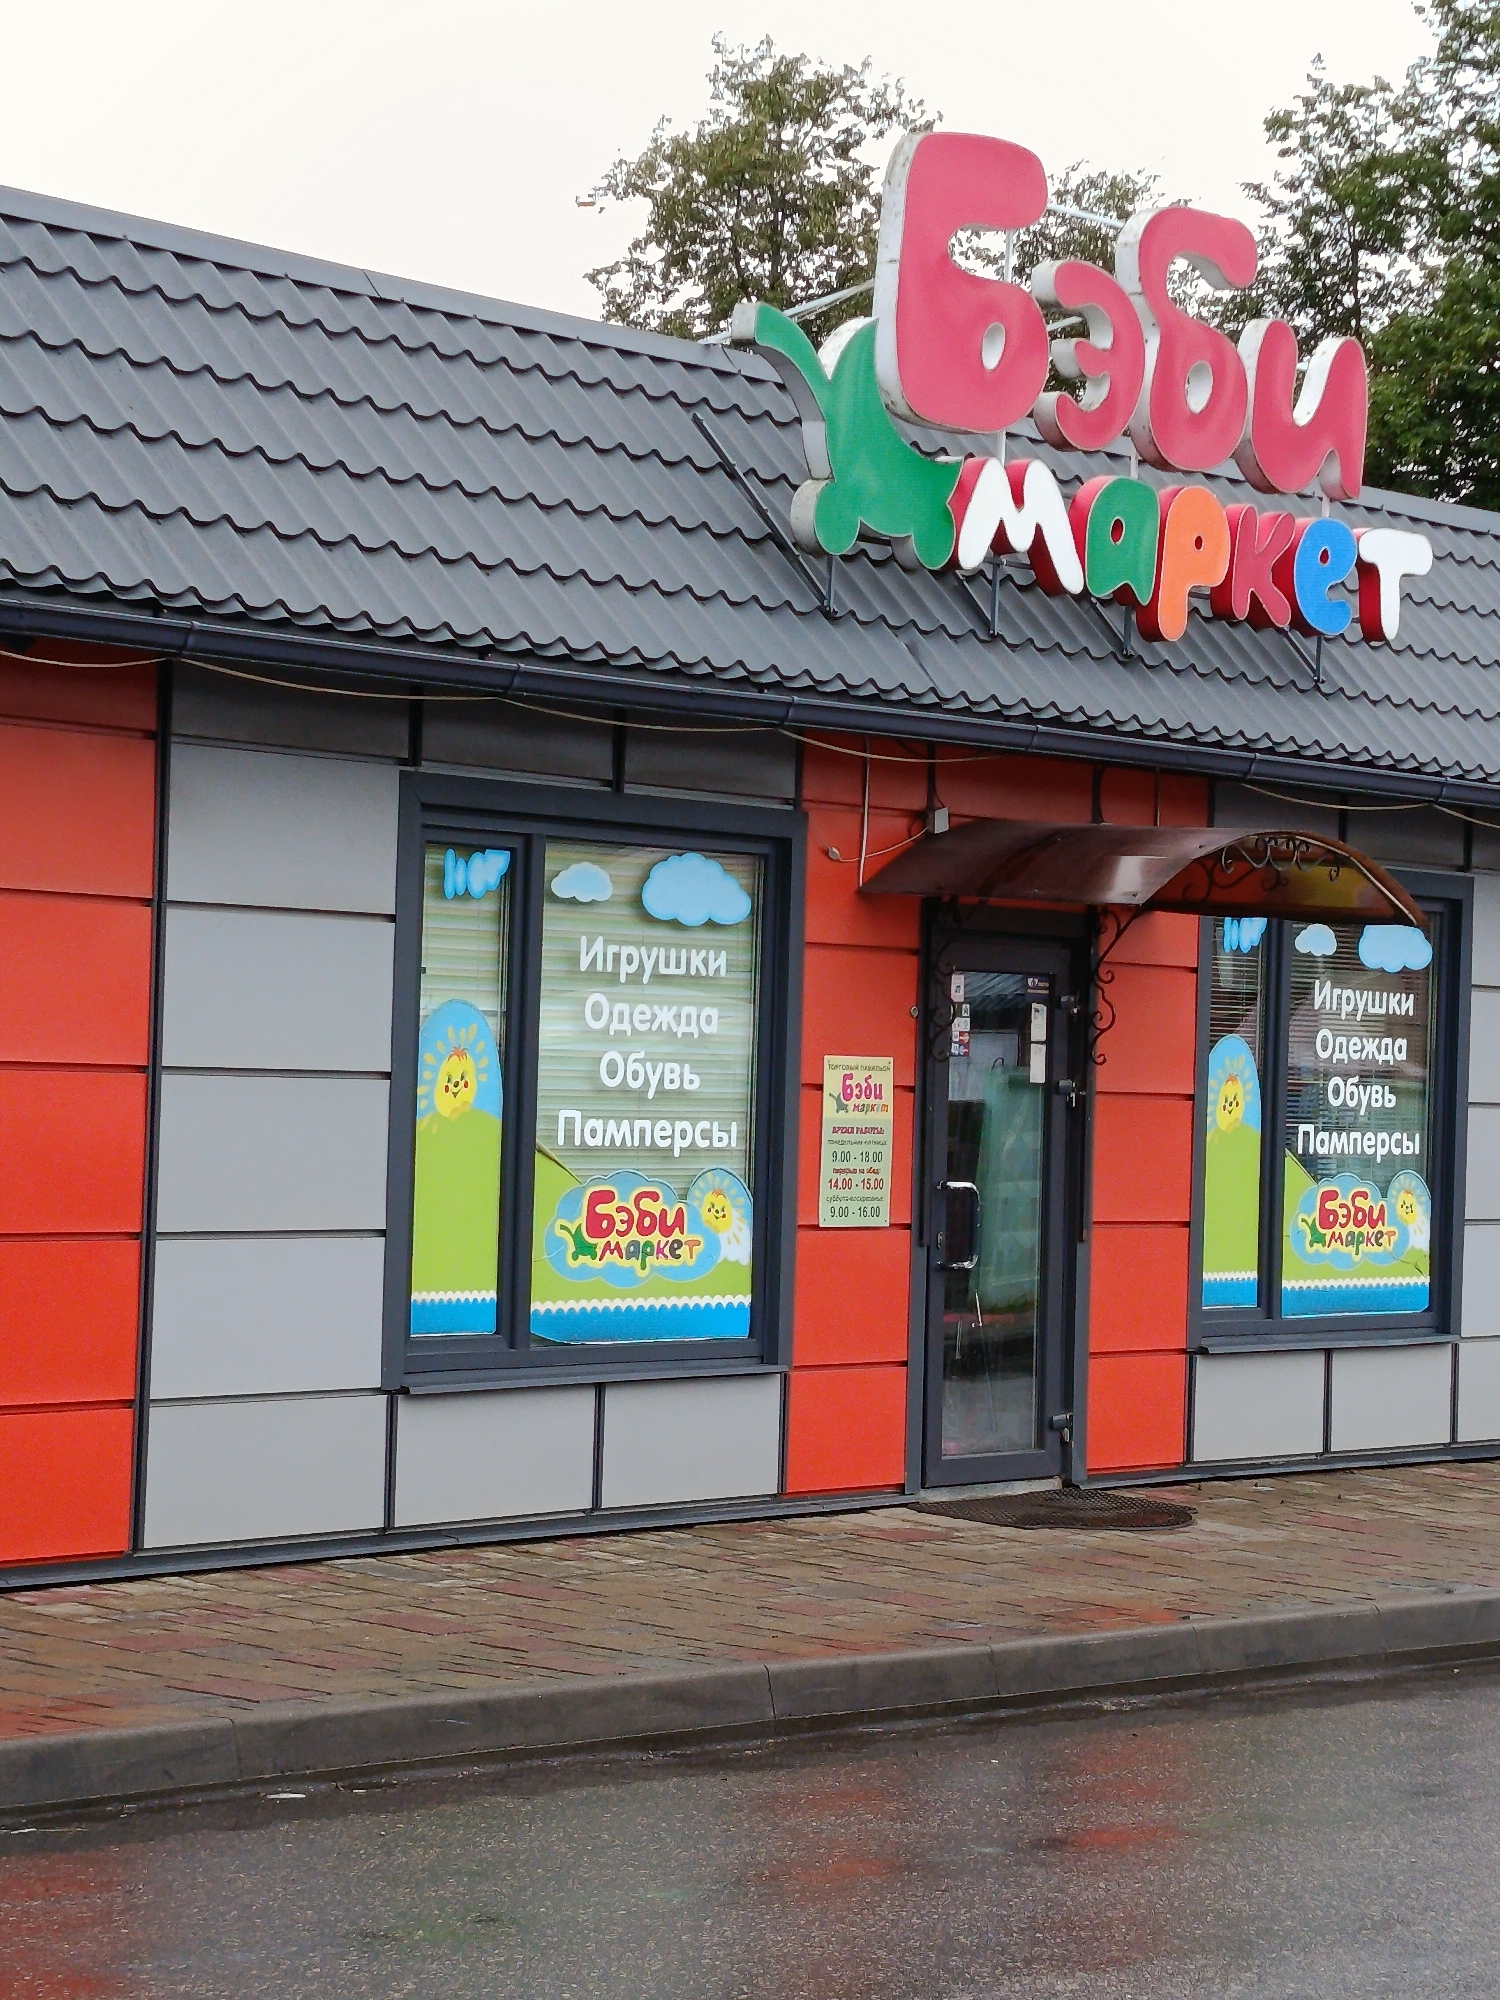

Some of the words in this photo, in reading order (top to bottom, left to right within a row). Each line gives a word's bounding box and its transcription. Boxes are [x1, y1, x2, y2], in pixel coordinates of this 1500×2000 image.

[873, 131, 1368, 499] Бэби
[950, 457, 1432, 642] маркет
[579, 935, 727, 985] Игрушки
[584, 992, 719, 1038] Одежда
[1313, 979, 1415, 1021] Игрушки
[1315, 1028, 1407, 1065] Одежда
[600, 1050, 701, 1100] Обувь
[842, 1072, 883, 1101] Бэби
[1327, 1075, 1396, 1116] Обувь
[557, 1109, 738, 1158] Памперсы
[1297, 1124, 1420, 1163] Памперсы
[832, 1150, 851, 1163] 9.00
[859, 1150, 883, 1163] 18.00
[828, 1177, 853, 1190] 14.00
[585, 1189, 685, 1239] Бэби
[830, 1205, 849, 1218] 9.00
[858, 1205, 881, 1218] 16.00
[1318, 1189, 1386, 1230] Бэби
[599, 1238, 702, 1270] маркет
[1326, 1230, 1396, 1256] маркет
